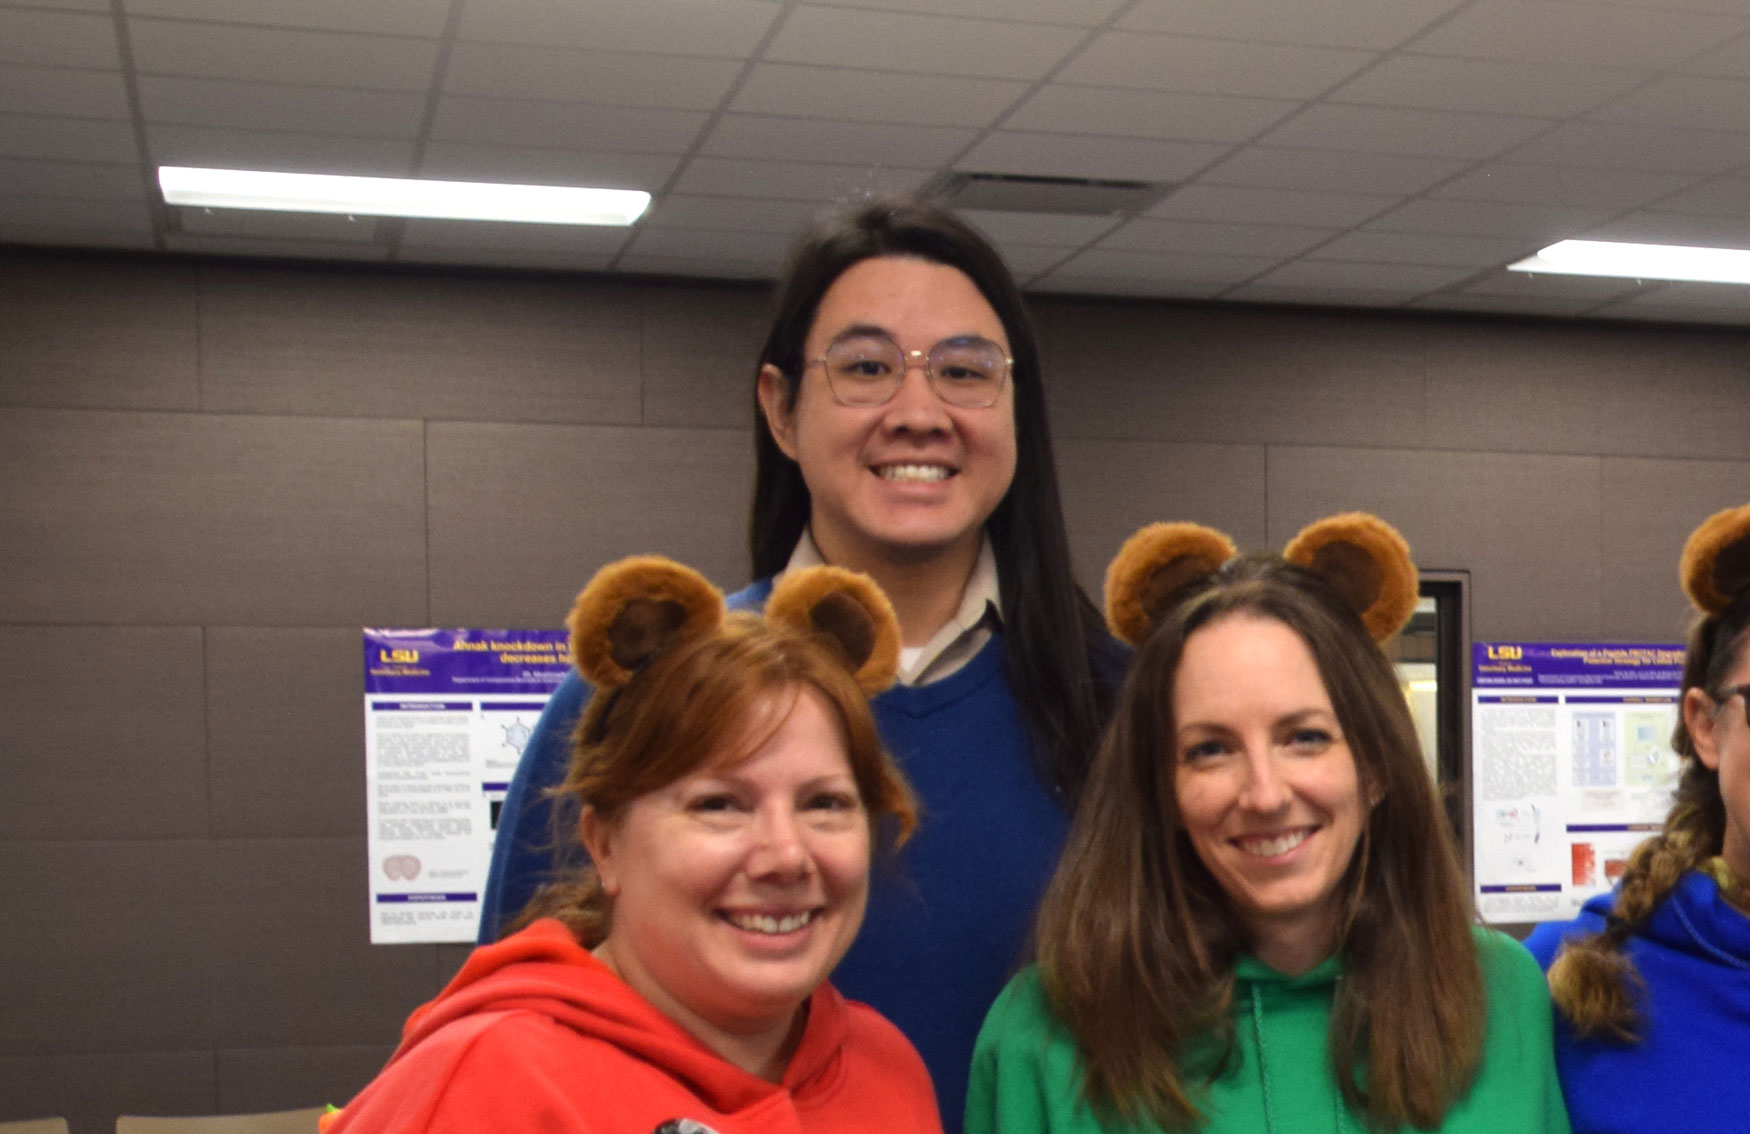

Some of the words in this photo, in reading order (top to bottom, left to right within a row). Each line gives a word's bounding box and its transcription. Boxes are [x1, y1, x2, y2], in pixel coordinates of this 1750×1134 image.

[491, 640, 553, 651] knockdown
[380, 649, 419, 664] LSU
[500, 653, 556, 664] decreases
[1487, 646, 1522, 660] LSU
